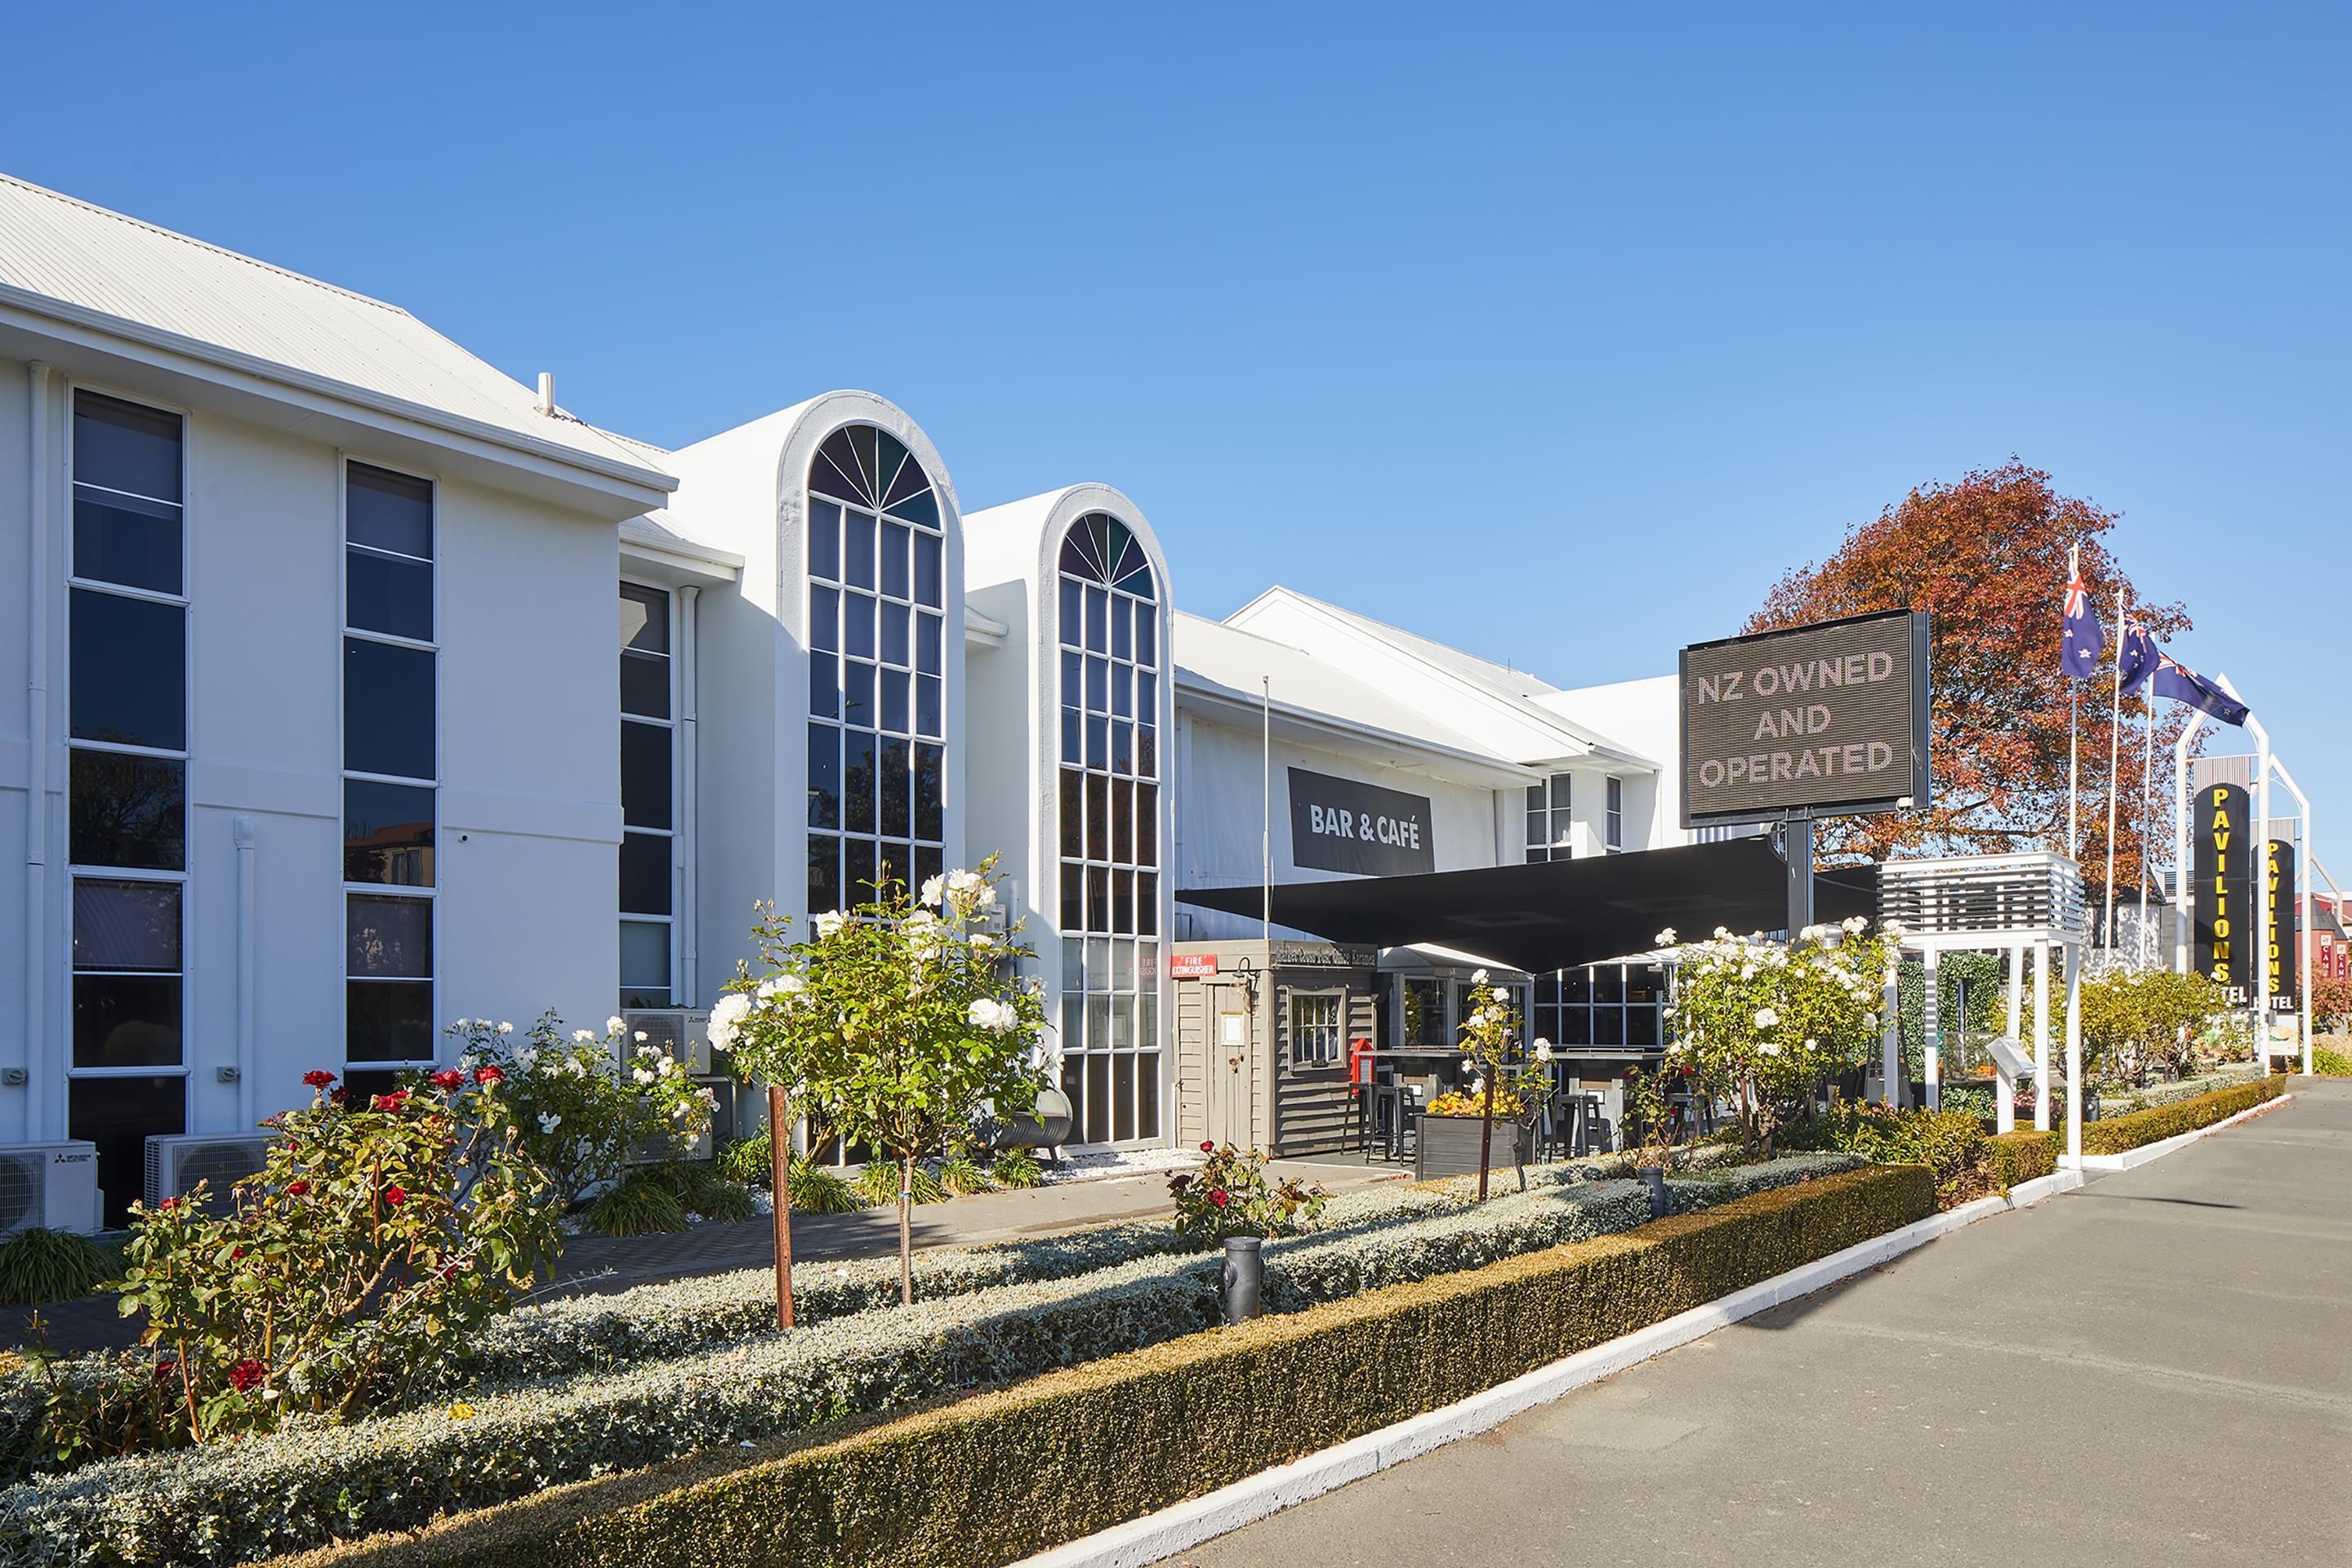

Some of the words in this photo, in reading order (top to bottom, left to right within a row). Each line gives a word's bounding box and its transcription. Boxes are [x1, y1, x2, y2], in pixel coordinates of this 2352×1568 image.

[1699, 671, 1744, 705] NZ
[1754, 652, 1893, 696] OWNED
[1754, 705, 1831, 740] AND
[1699, 742, 1893, 787] OPERATED
[1310, 804, 1354, 838] BAR
[1359, 813, 1375, 841] &
[1376, 815, 1419, 849] CAFÉ
[2212, 788, 2230, 982] PAVILIONS
[2268, 843, 2279, 993] PAVILIONS
[1173, 965, 1214, 975] EXTINGUISHER
[1185, 956, 1203, 965] FIRE
[2221, 987, 2247, 1004] TEL
[2253, 996, 2294, 1009] HTEL
